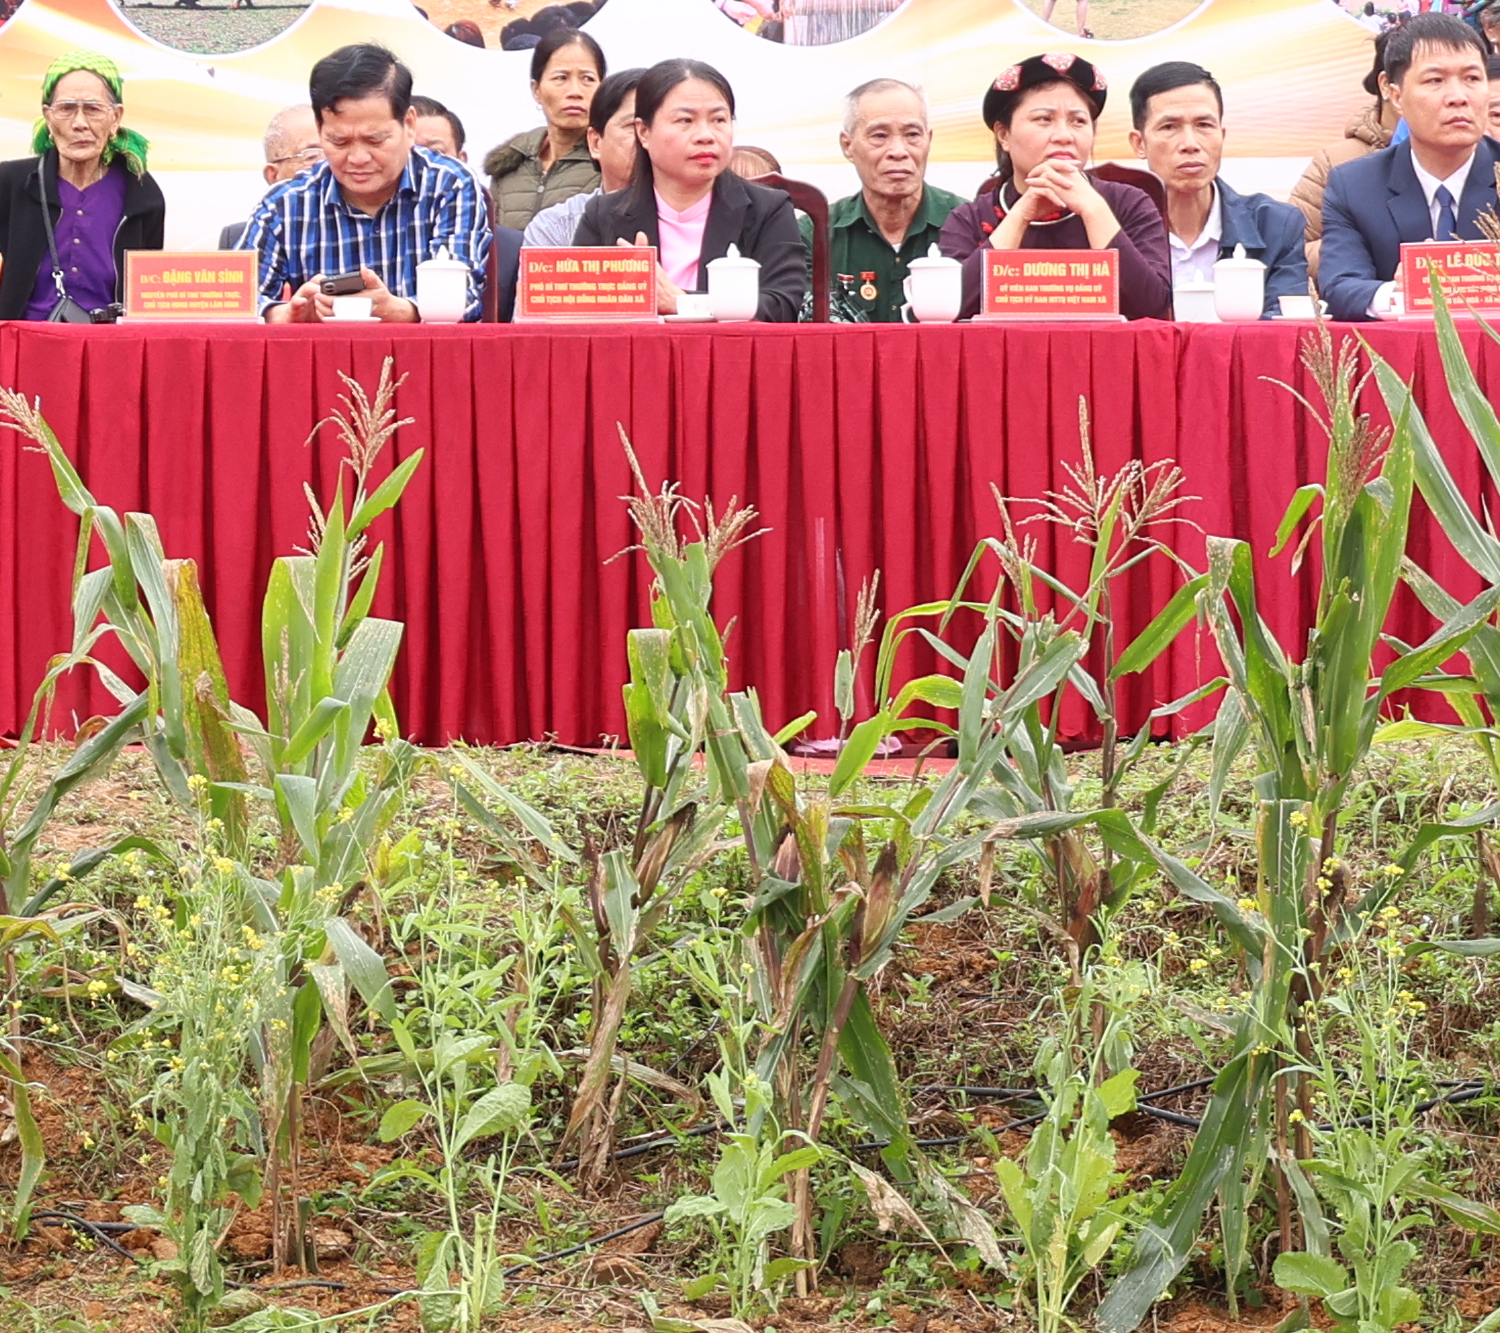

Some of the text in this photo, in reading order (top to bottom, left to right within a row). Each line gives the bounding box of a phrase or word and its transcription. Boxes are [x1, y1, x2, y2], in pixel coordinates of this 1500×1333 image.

[529, 258, 649, 275] Đ/c: HỨA THỊ PHƯƠNG
[992, 260, 1110, 279] Đ/c: DƯƠNG THỊ HÀ
[163, 269, 192, 286] ĐẶNG
[194, 269, 216, 283] VĂN
